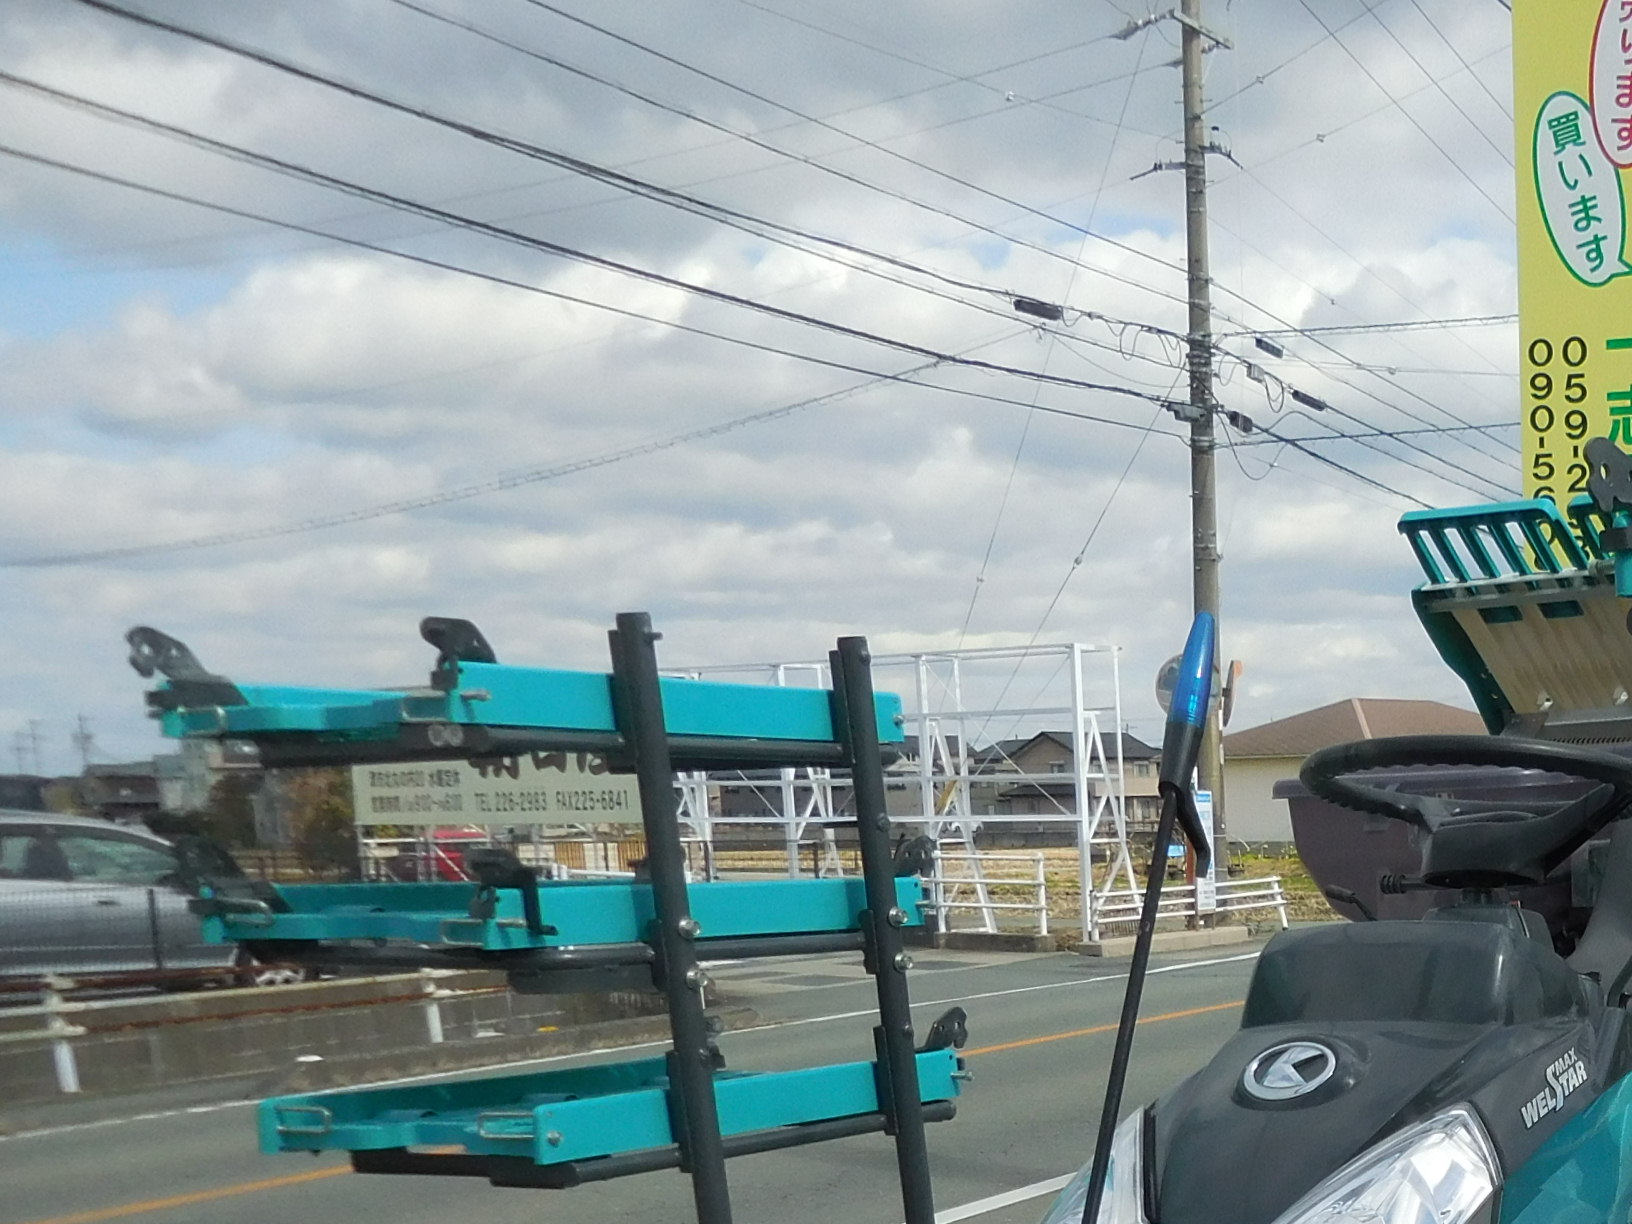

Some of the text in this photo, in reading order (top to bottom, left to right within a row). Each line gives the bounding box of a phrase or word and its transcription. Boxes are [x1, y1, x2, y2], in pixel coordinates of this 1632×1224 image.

[1547, 109, 1609, 273] 買います
[1562, 336, 1591, 528] 059-2
